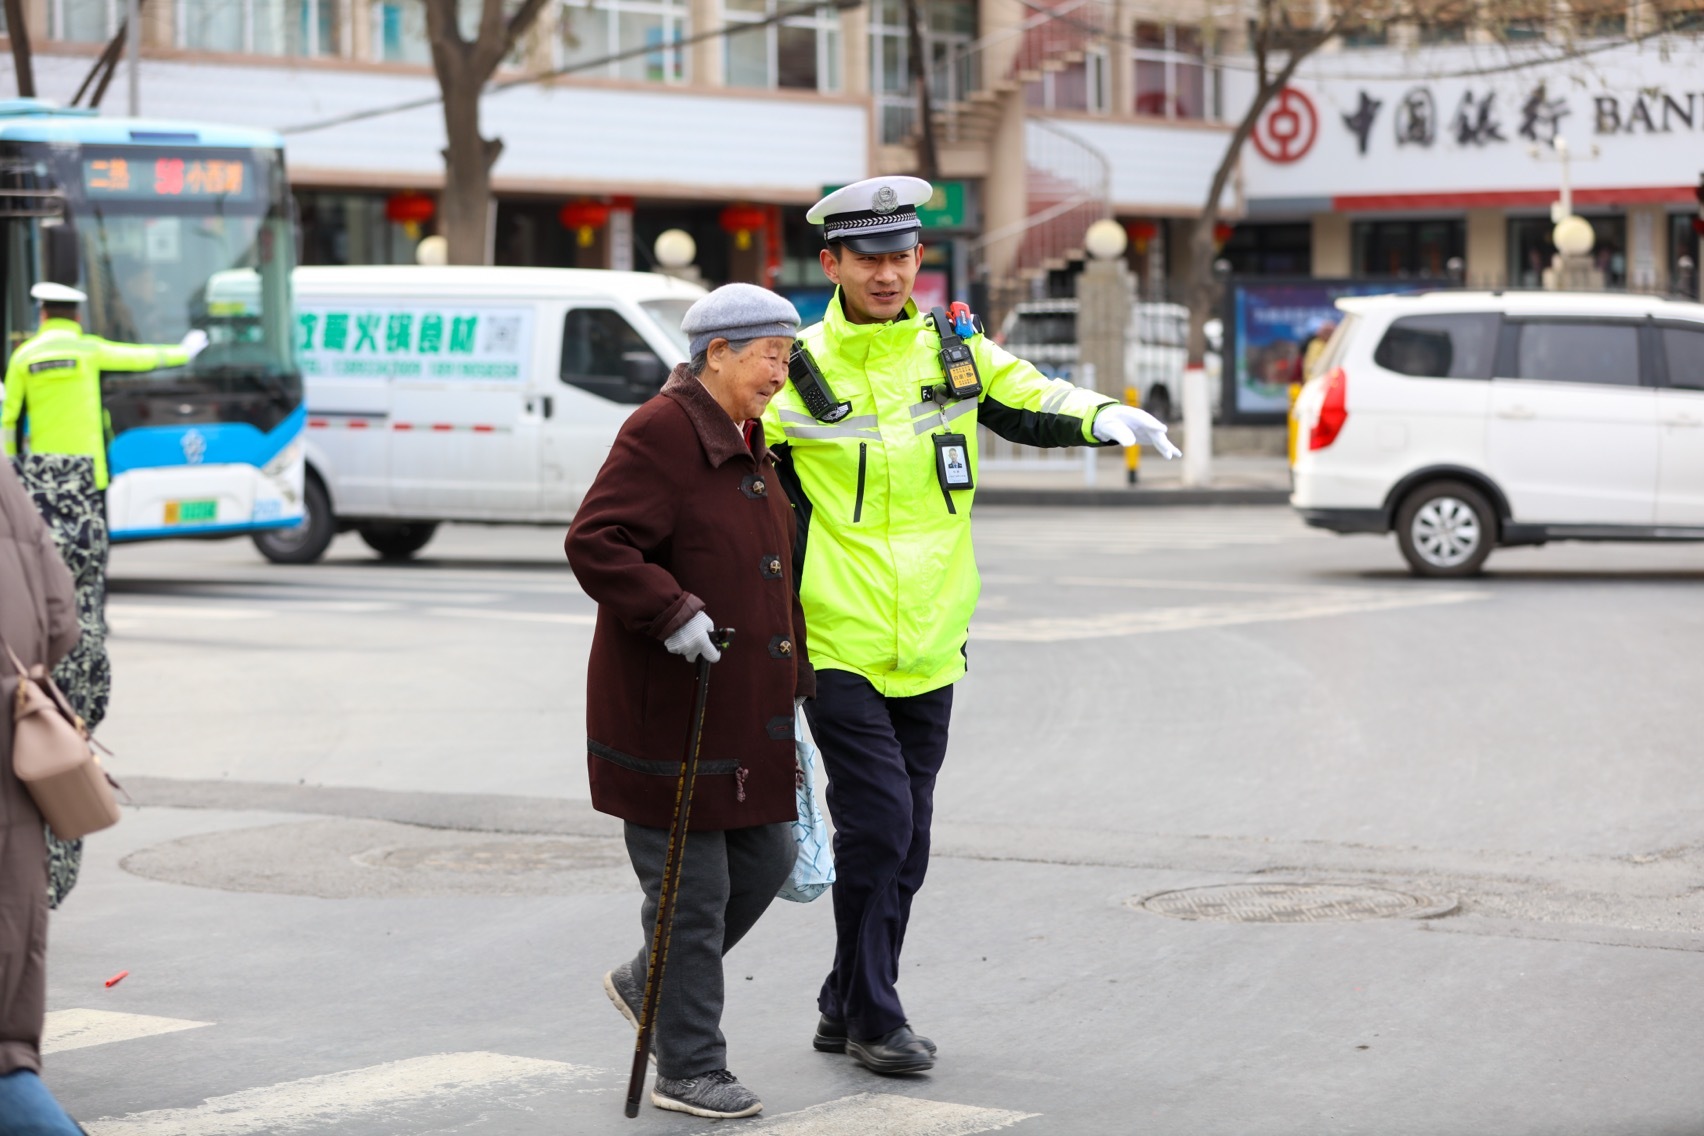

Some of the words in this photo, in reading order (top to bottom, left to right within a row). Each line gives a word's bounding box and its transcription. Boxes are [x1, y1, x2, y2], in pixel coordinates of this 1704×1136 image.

[1342, 86, 1572, 156] 中国银行
[1593, 93, 1704, 134] BAN
